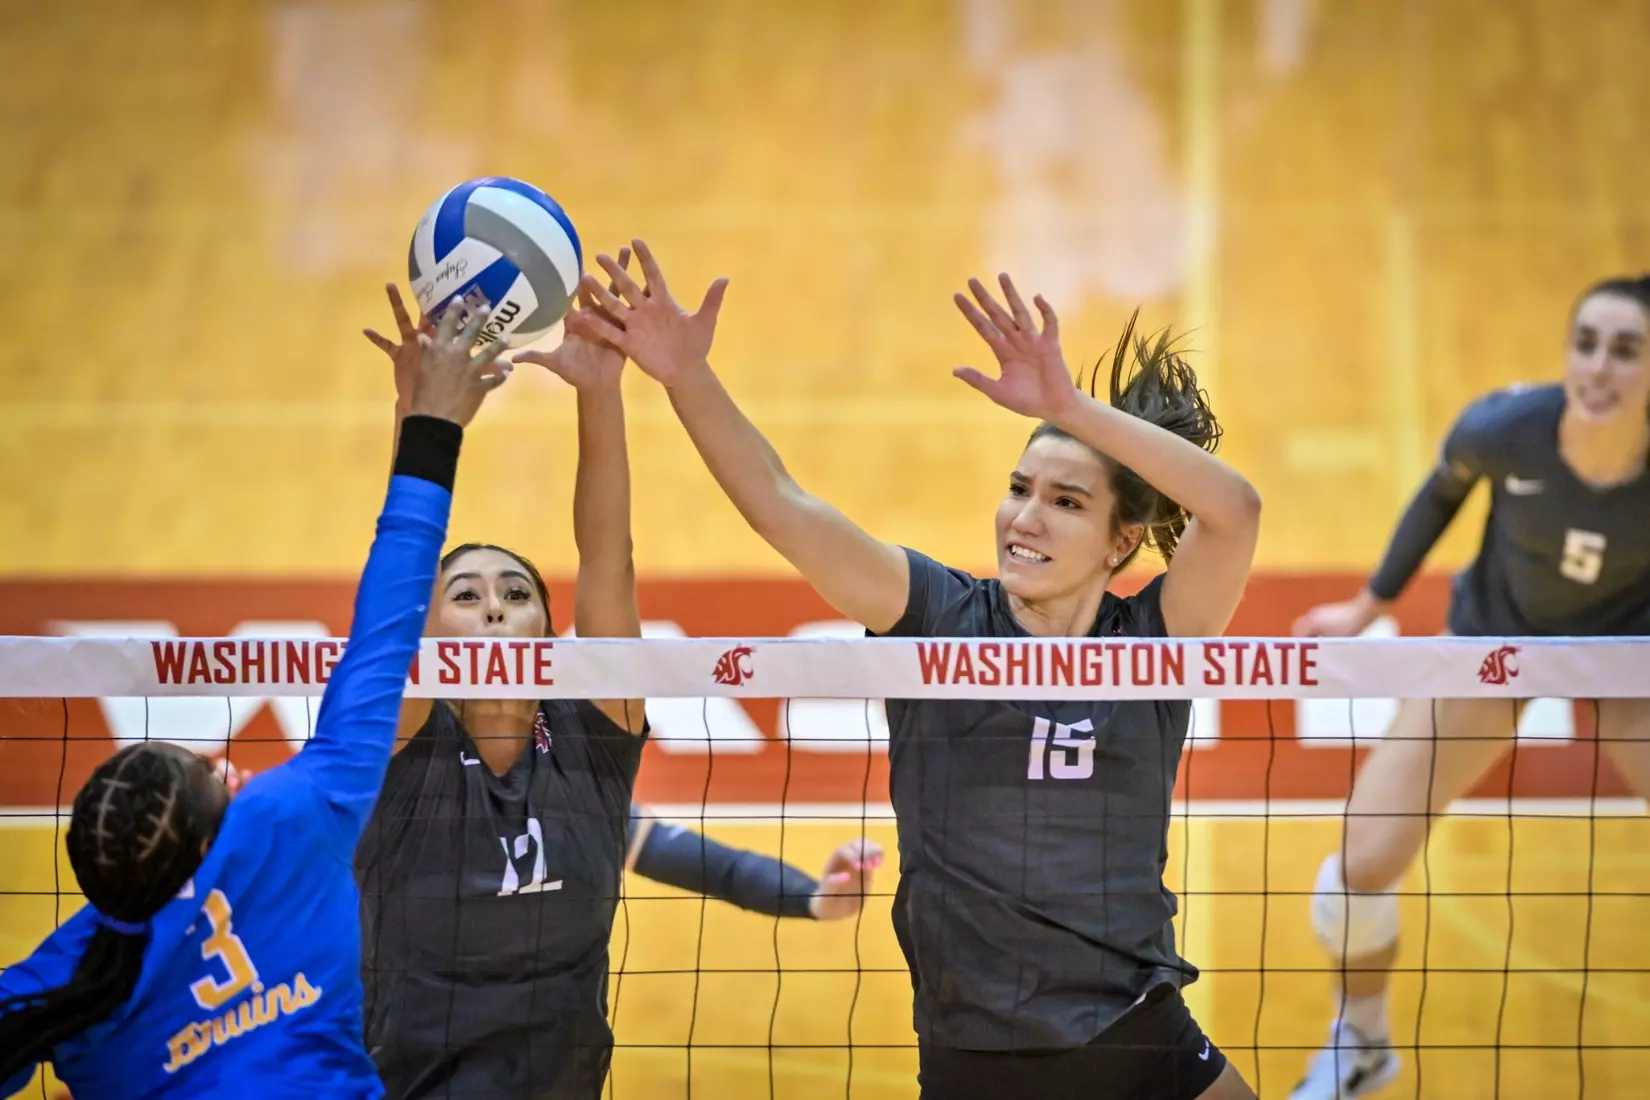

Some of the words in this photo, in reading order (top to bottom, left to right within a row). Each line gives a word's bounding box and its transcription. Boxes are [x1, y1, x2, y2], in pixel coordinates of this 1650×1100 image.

[475, 300, 521, 346] molte
[1560, 527, 1607, 585] 5
[152, 641, 420, 686] WASHING
[437, 641, 554, 686] STATE
[916, 642, 1185, 686] WASHINGTON
[1202, 642, 1319, 686] STATE
[1027, 715, 1097, 780] 15
[497, 817, 563, 896] 12
[189, 887, 260, 1011] 3
